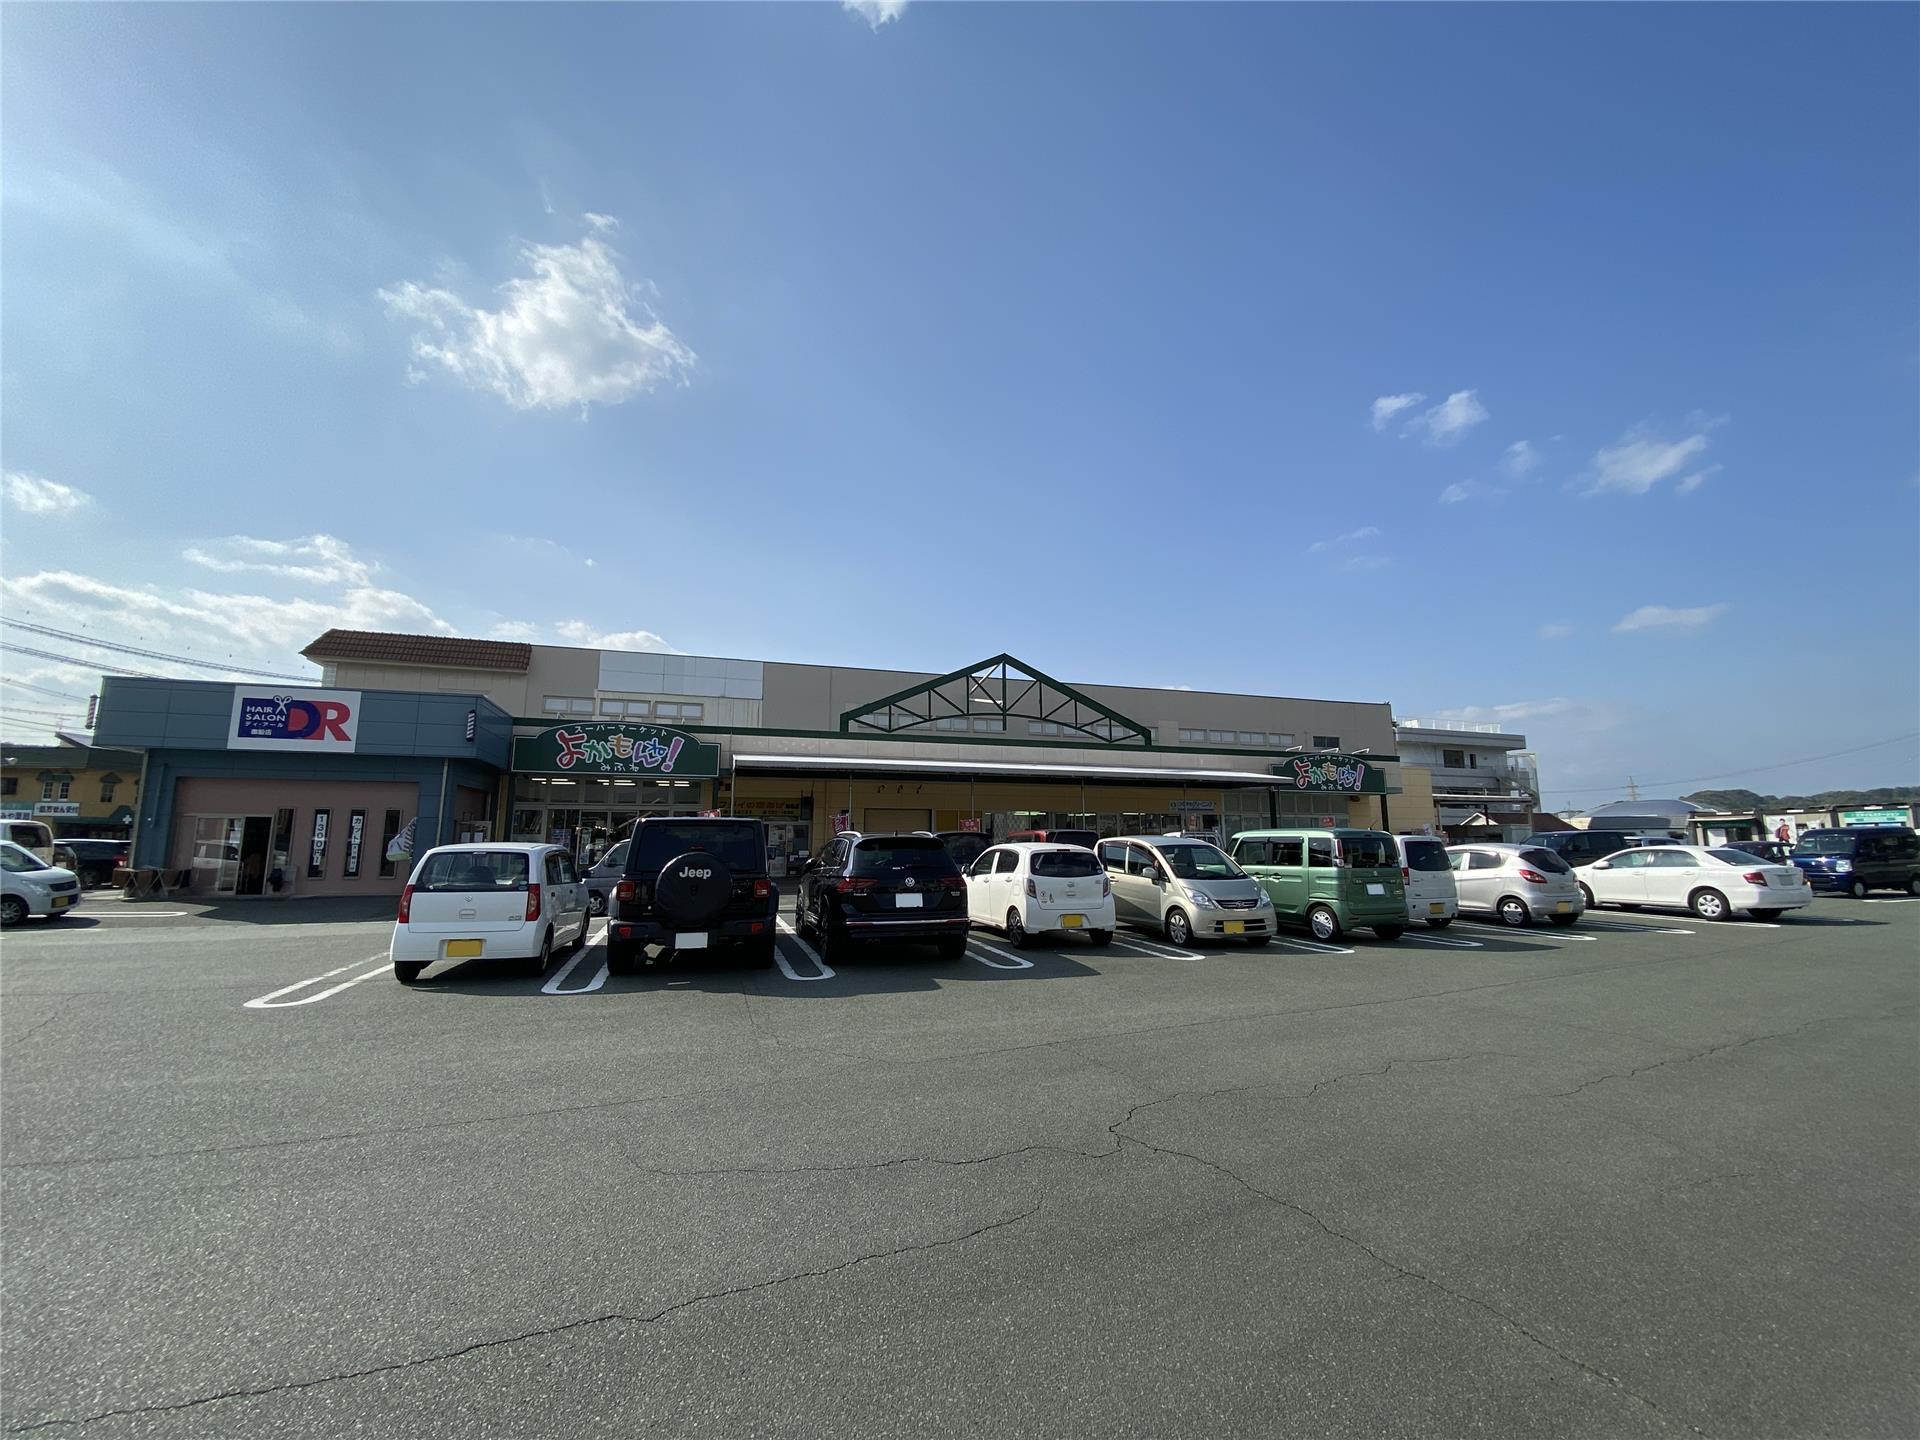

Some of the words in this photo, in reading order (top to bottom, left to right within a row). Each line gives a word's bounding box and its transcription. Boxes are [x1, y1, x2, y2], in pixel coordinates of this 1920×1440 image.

[245, 714, 286, 722] SALON
[285, 700, 352, 741] DR
[574, 725, 668, 737] スーパーマーケット
[600, 762, 640, 773] みふね
[679, 866, 712, 880] Jeep
